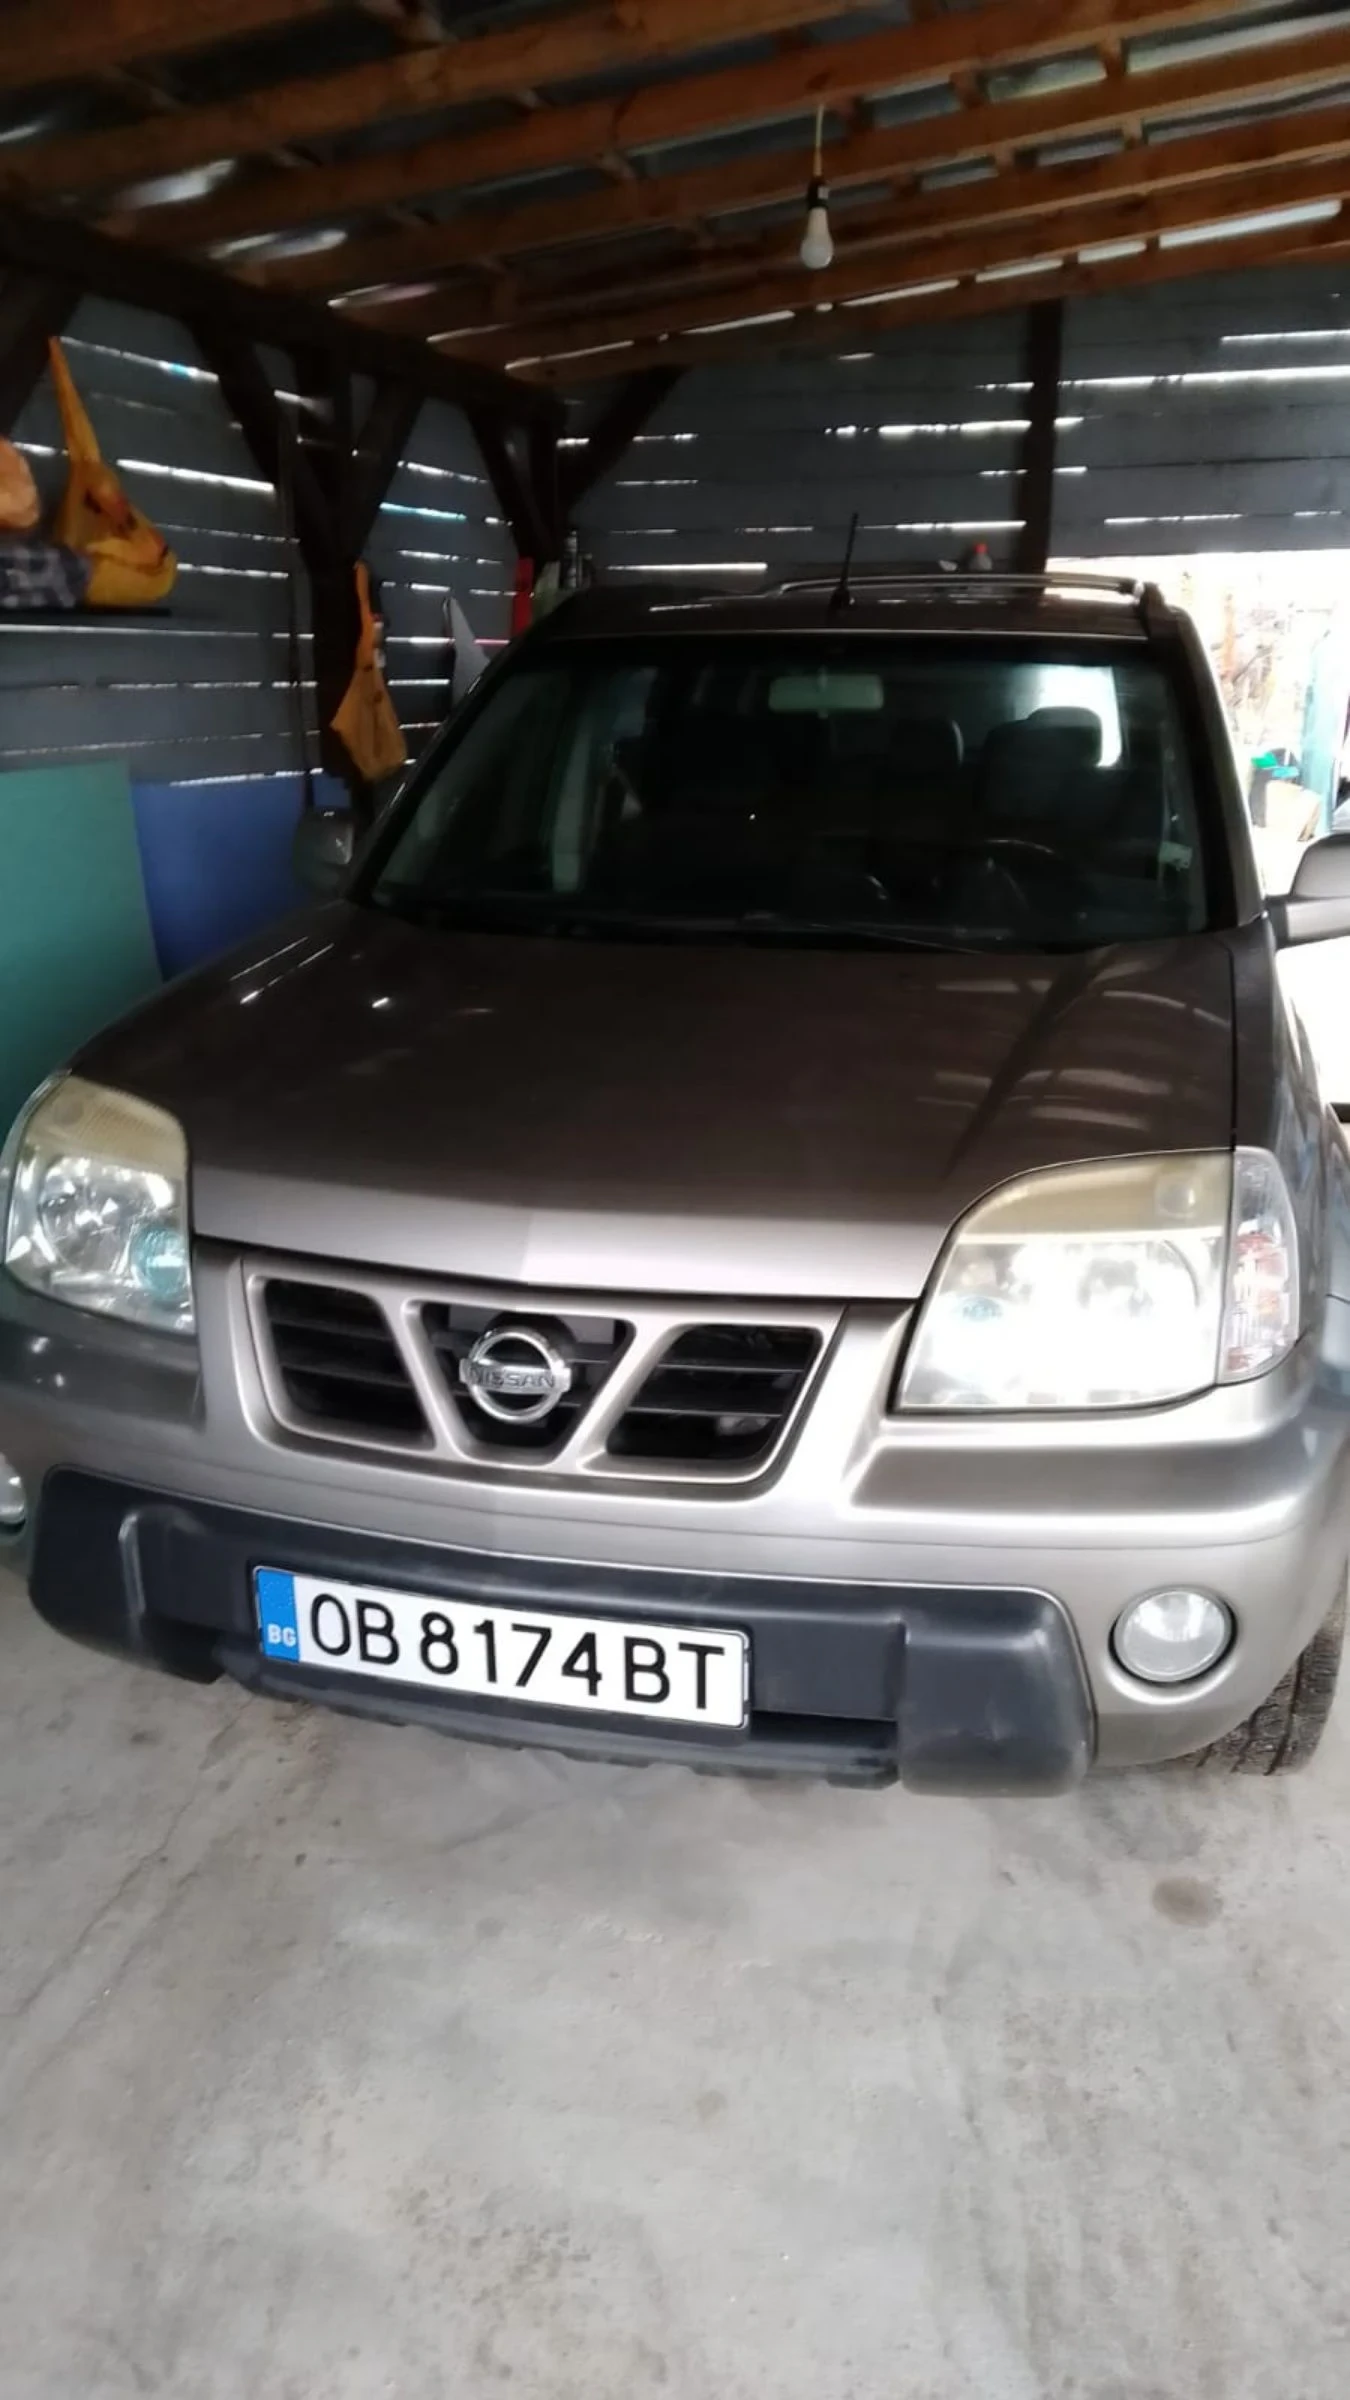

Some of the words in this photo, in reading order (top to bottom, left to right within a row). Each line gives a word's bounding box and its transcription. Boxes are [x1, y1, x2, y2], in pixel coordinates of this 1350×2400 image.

[470, 1365, 556, 1388] NISSAN
[267, 1623, 296, 1647] BG
[310, 1593, 400, 1666] OB
[419, 1611, 603, 1697] 8174
[623, 1635, 725, 1710] BT
